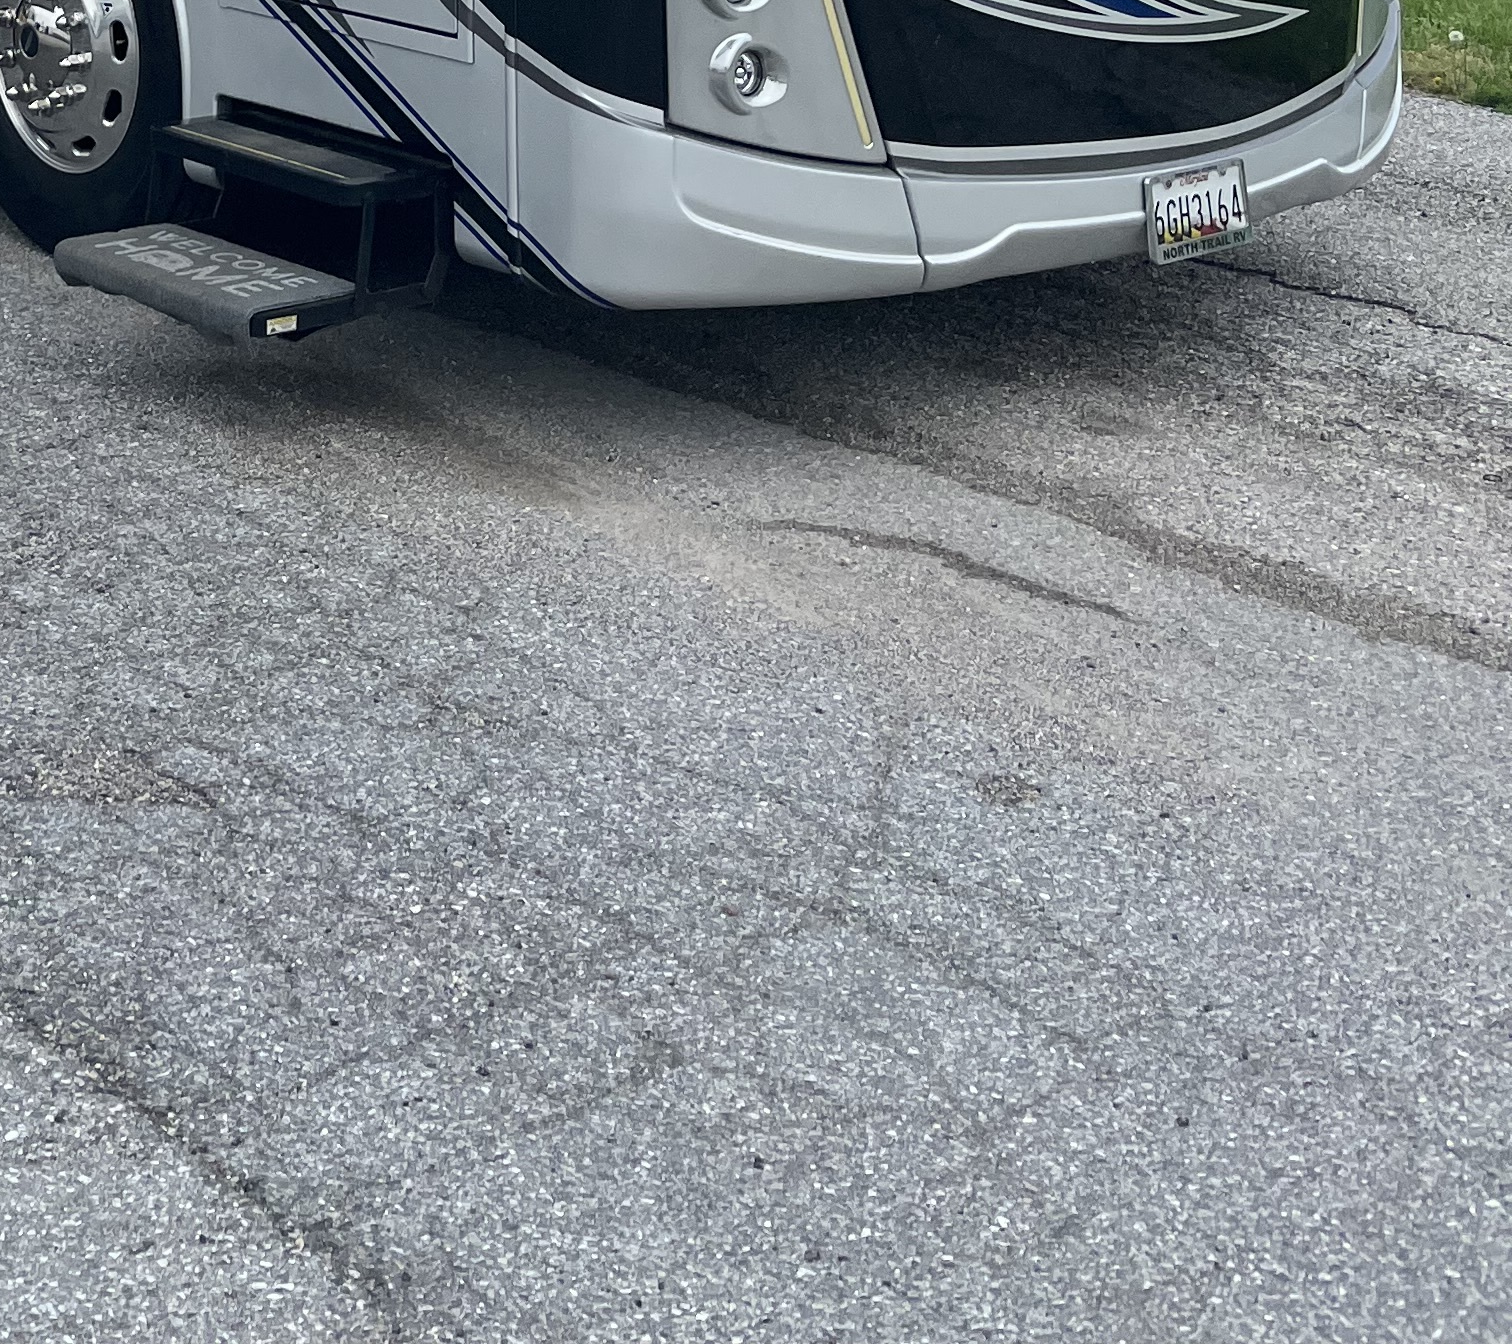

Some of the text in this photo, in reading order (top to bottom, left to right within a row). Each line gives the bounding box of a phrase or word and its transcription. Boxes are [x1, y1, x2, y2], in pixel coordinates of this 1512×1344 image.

[1154, 183, 1242, 240] 6GH3164
[95, 238, 285, 298] HOME
[148, 230, 319, 288] WELCOME
[1162, 231, 1247, 260] NORTH TRAIL RV
